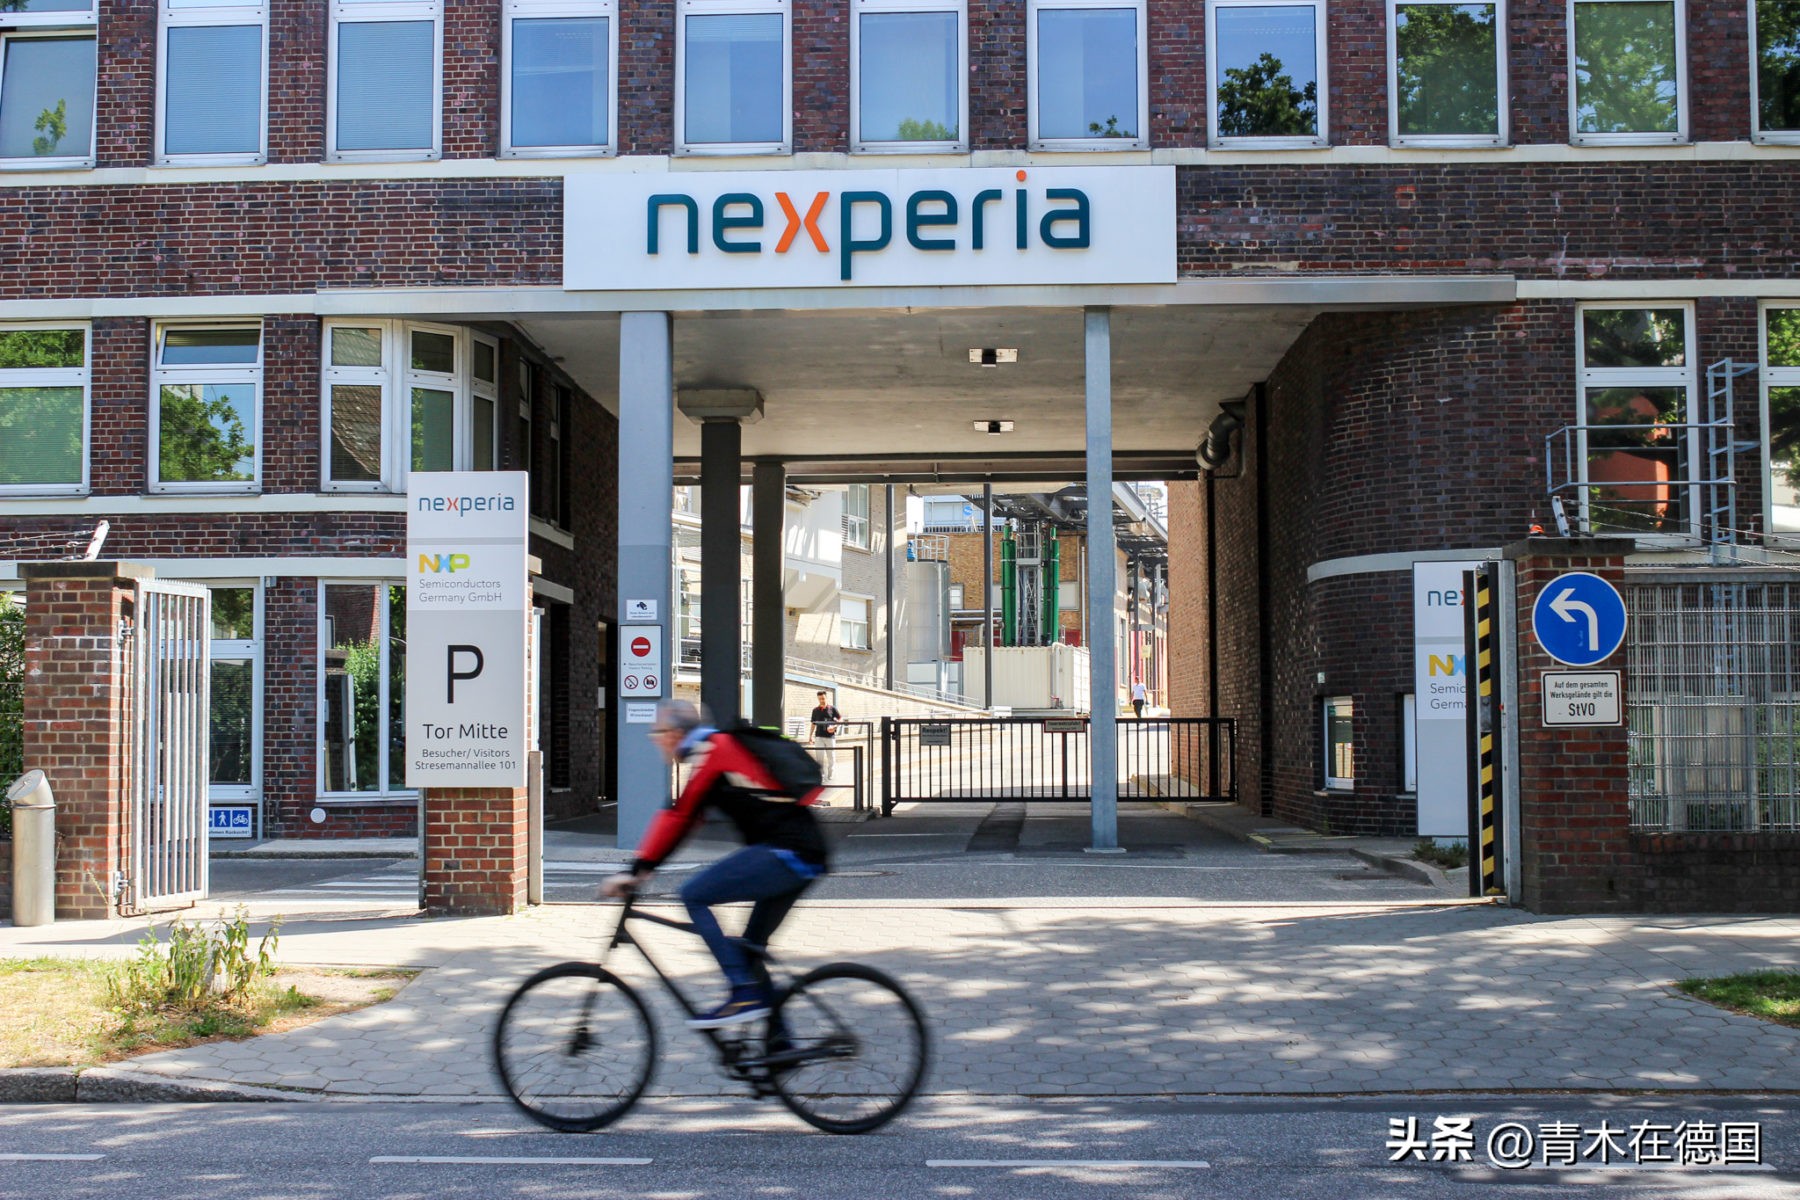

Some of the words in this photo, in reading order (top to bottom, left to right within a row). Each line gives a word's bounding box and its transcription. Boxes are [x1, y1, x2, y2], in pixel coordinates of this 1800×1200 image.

[647, 170, 1090, 281] nexperia
[418, 493, 515, 517] nexperia
[418, 554, 471, 574] NXP
[419, 579, 501, 589] Semiconductors
[419, 593, 465, 604] Germany
[468, 592, 502, 602] GmbH
[447, 644, 485, 704] P
[1554, 681, 1564, 689] Auf
[1580, 681, 1608, 689] gesamten
[1550, 691, 1591, 699] Werksgelände
[1593, 690, 1602, 699] gilt
[1604, 690, 1613, 698] die
[1568, 702, 1595, 716] StVO
[422, 723, 454, 739] Tor
[459, 723, 508, 739] Mitte
[422, 748, 471, 759] Besucher/
[473, 748, 510, 758] Visitors
[415, 760, 496, 770] Stresemannallee
[499, 761, 516, 770] 101
